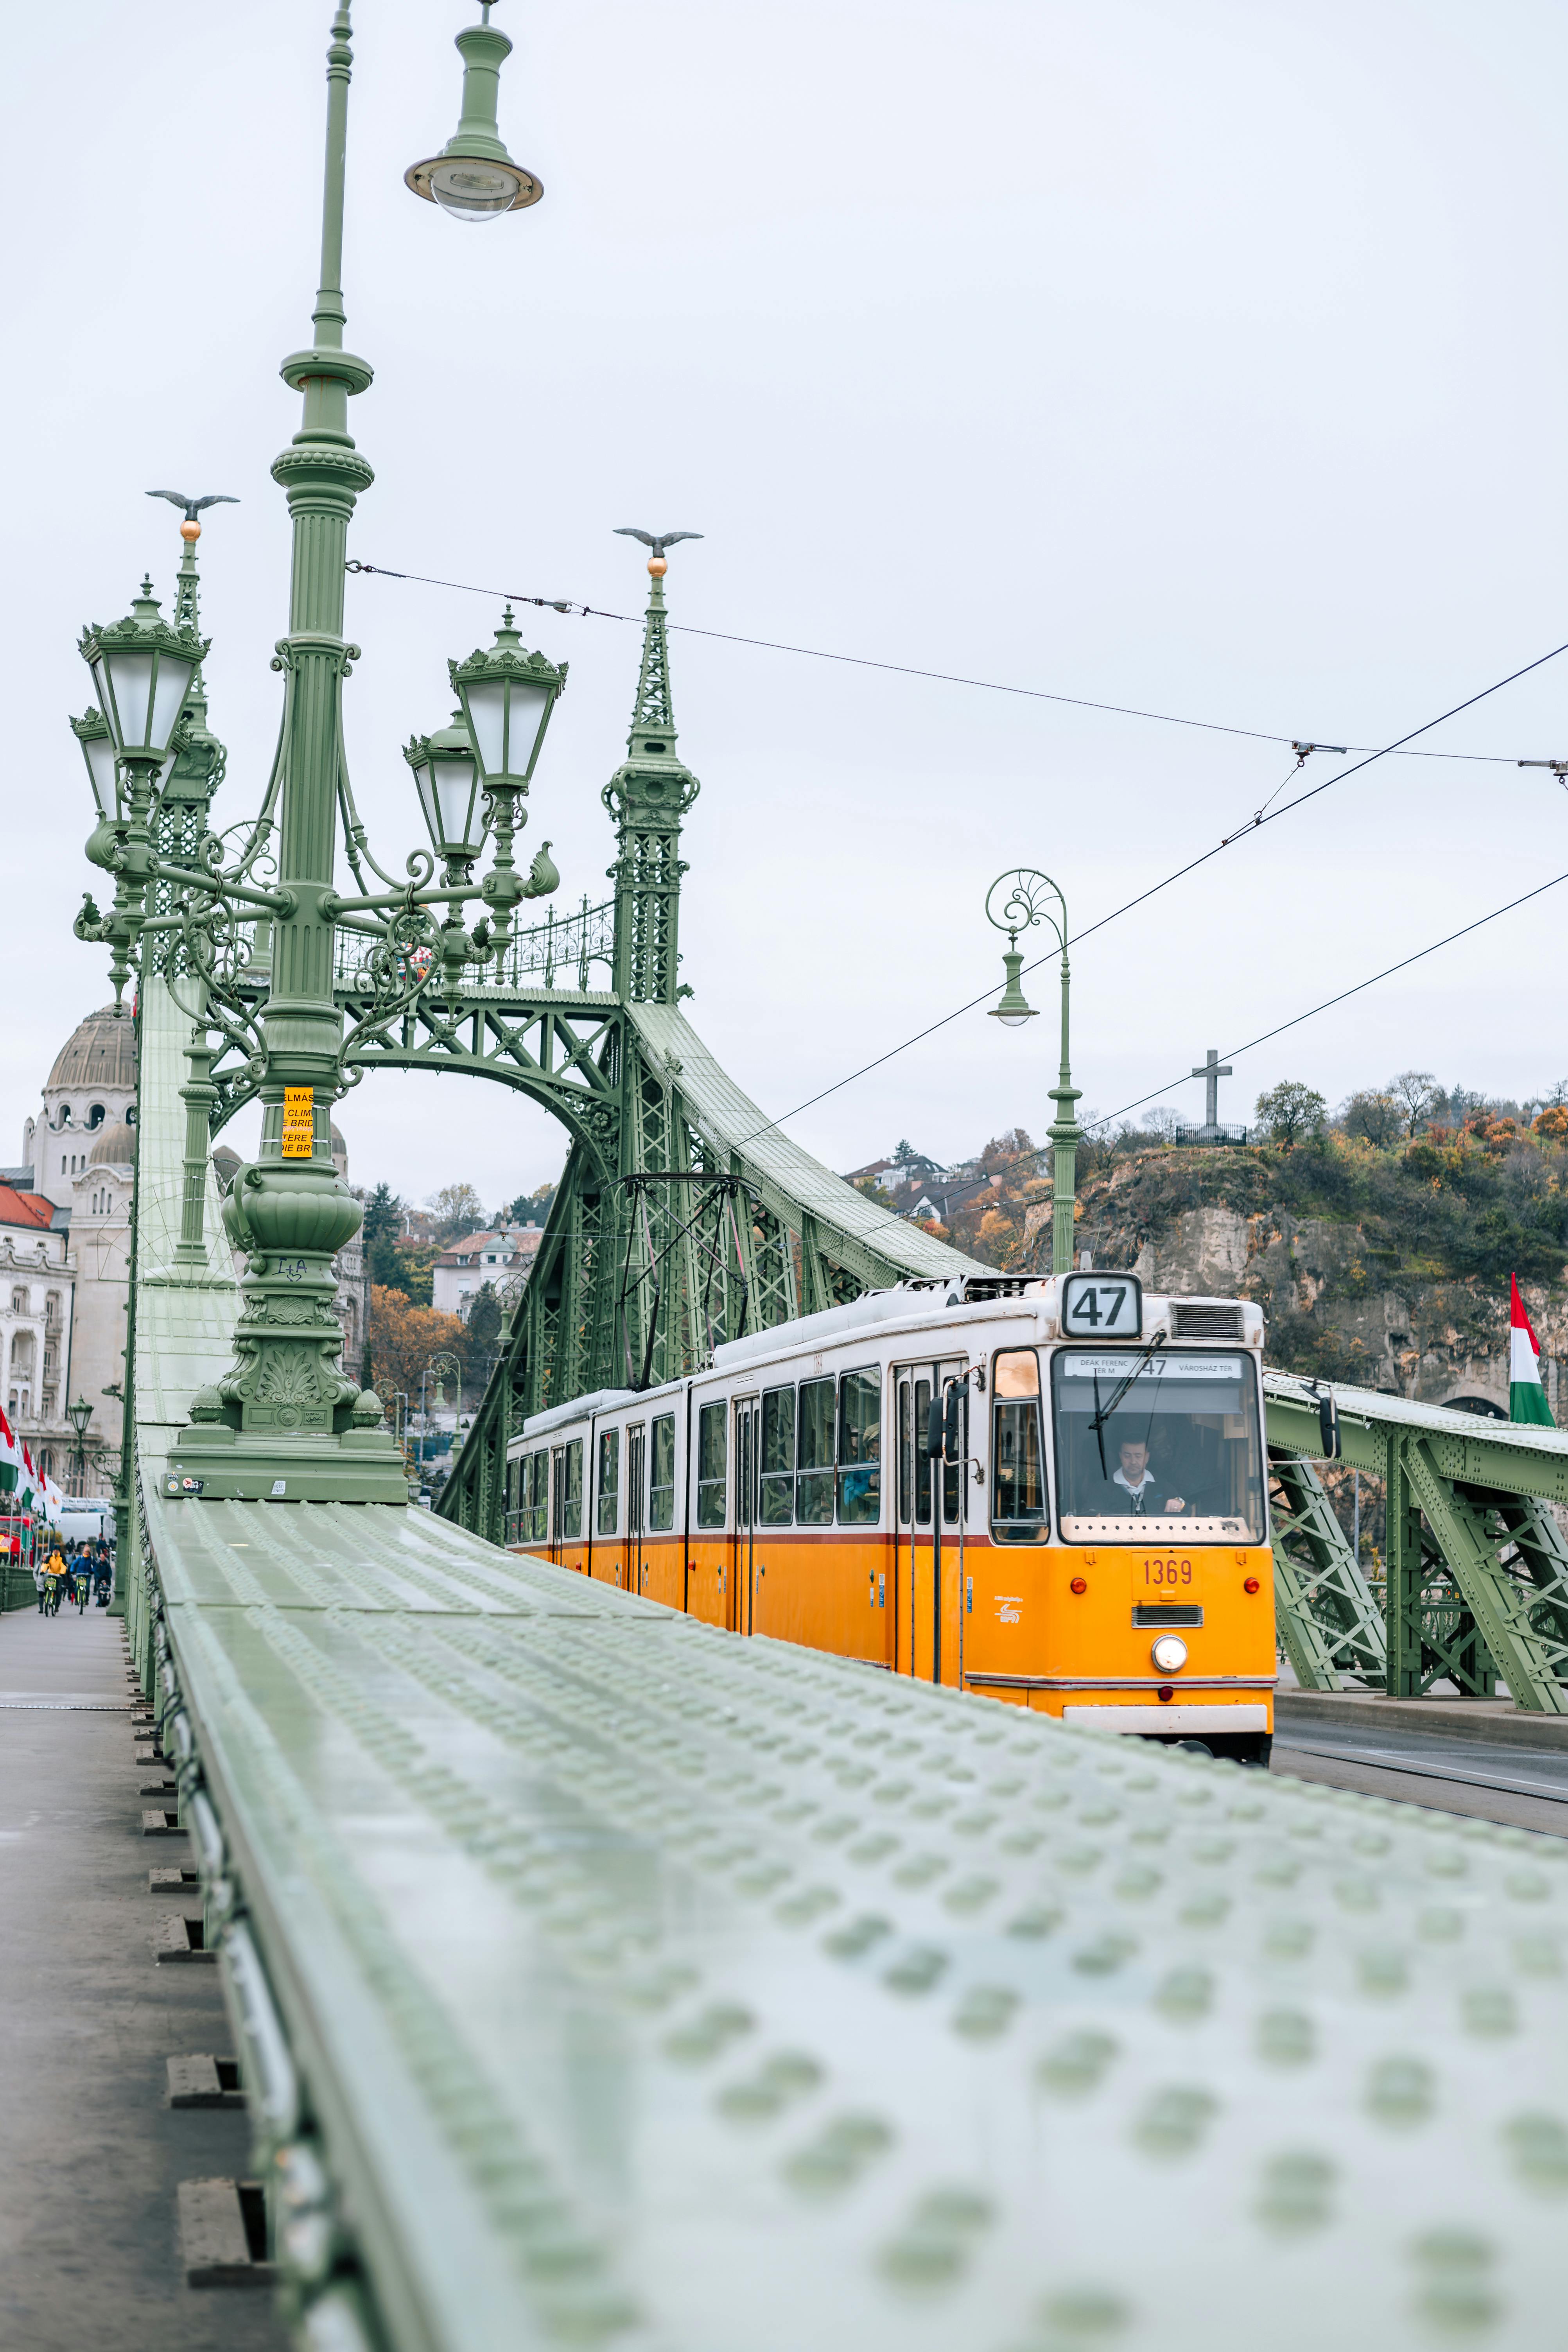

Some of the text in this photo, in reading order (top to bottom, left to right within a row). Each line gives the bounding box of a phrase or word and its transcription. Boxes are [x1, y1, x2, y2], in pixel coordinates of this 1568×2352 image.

[1073, 1287, 1126, 1326] 47
[1143, 1360, 1166, 1375] 47
[1144, 1559, 1191, 1584] 1369
